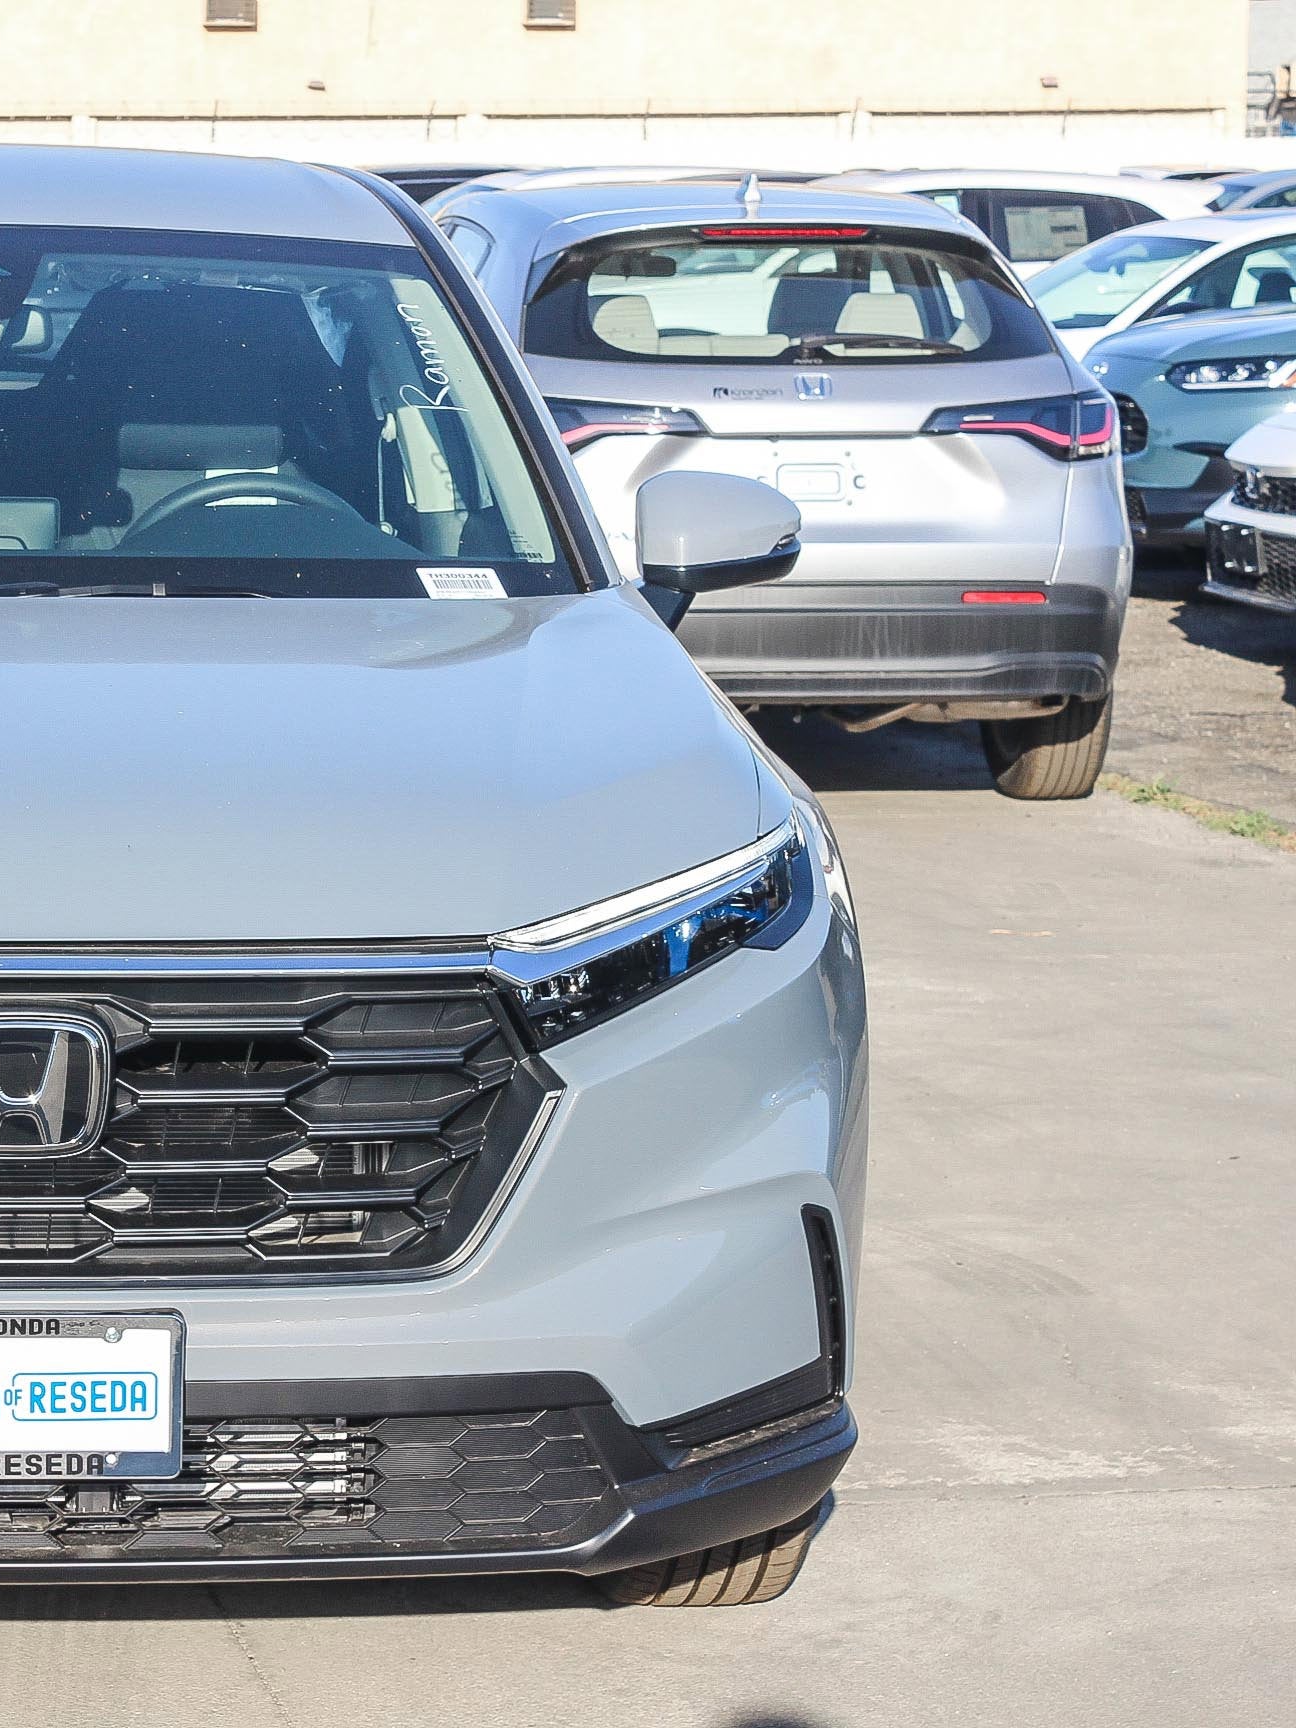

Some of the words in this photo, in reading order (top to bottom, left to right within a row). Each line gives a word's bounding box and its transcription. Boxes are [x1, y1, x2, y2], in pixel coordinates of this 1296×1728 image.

[397, 303, 470, 412] Ramon
[4, 1389, 23, 1406] OF
[29, 1380, 147, 1414] RESEDA
